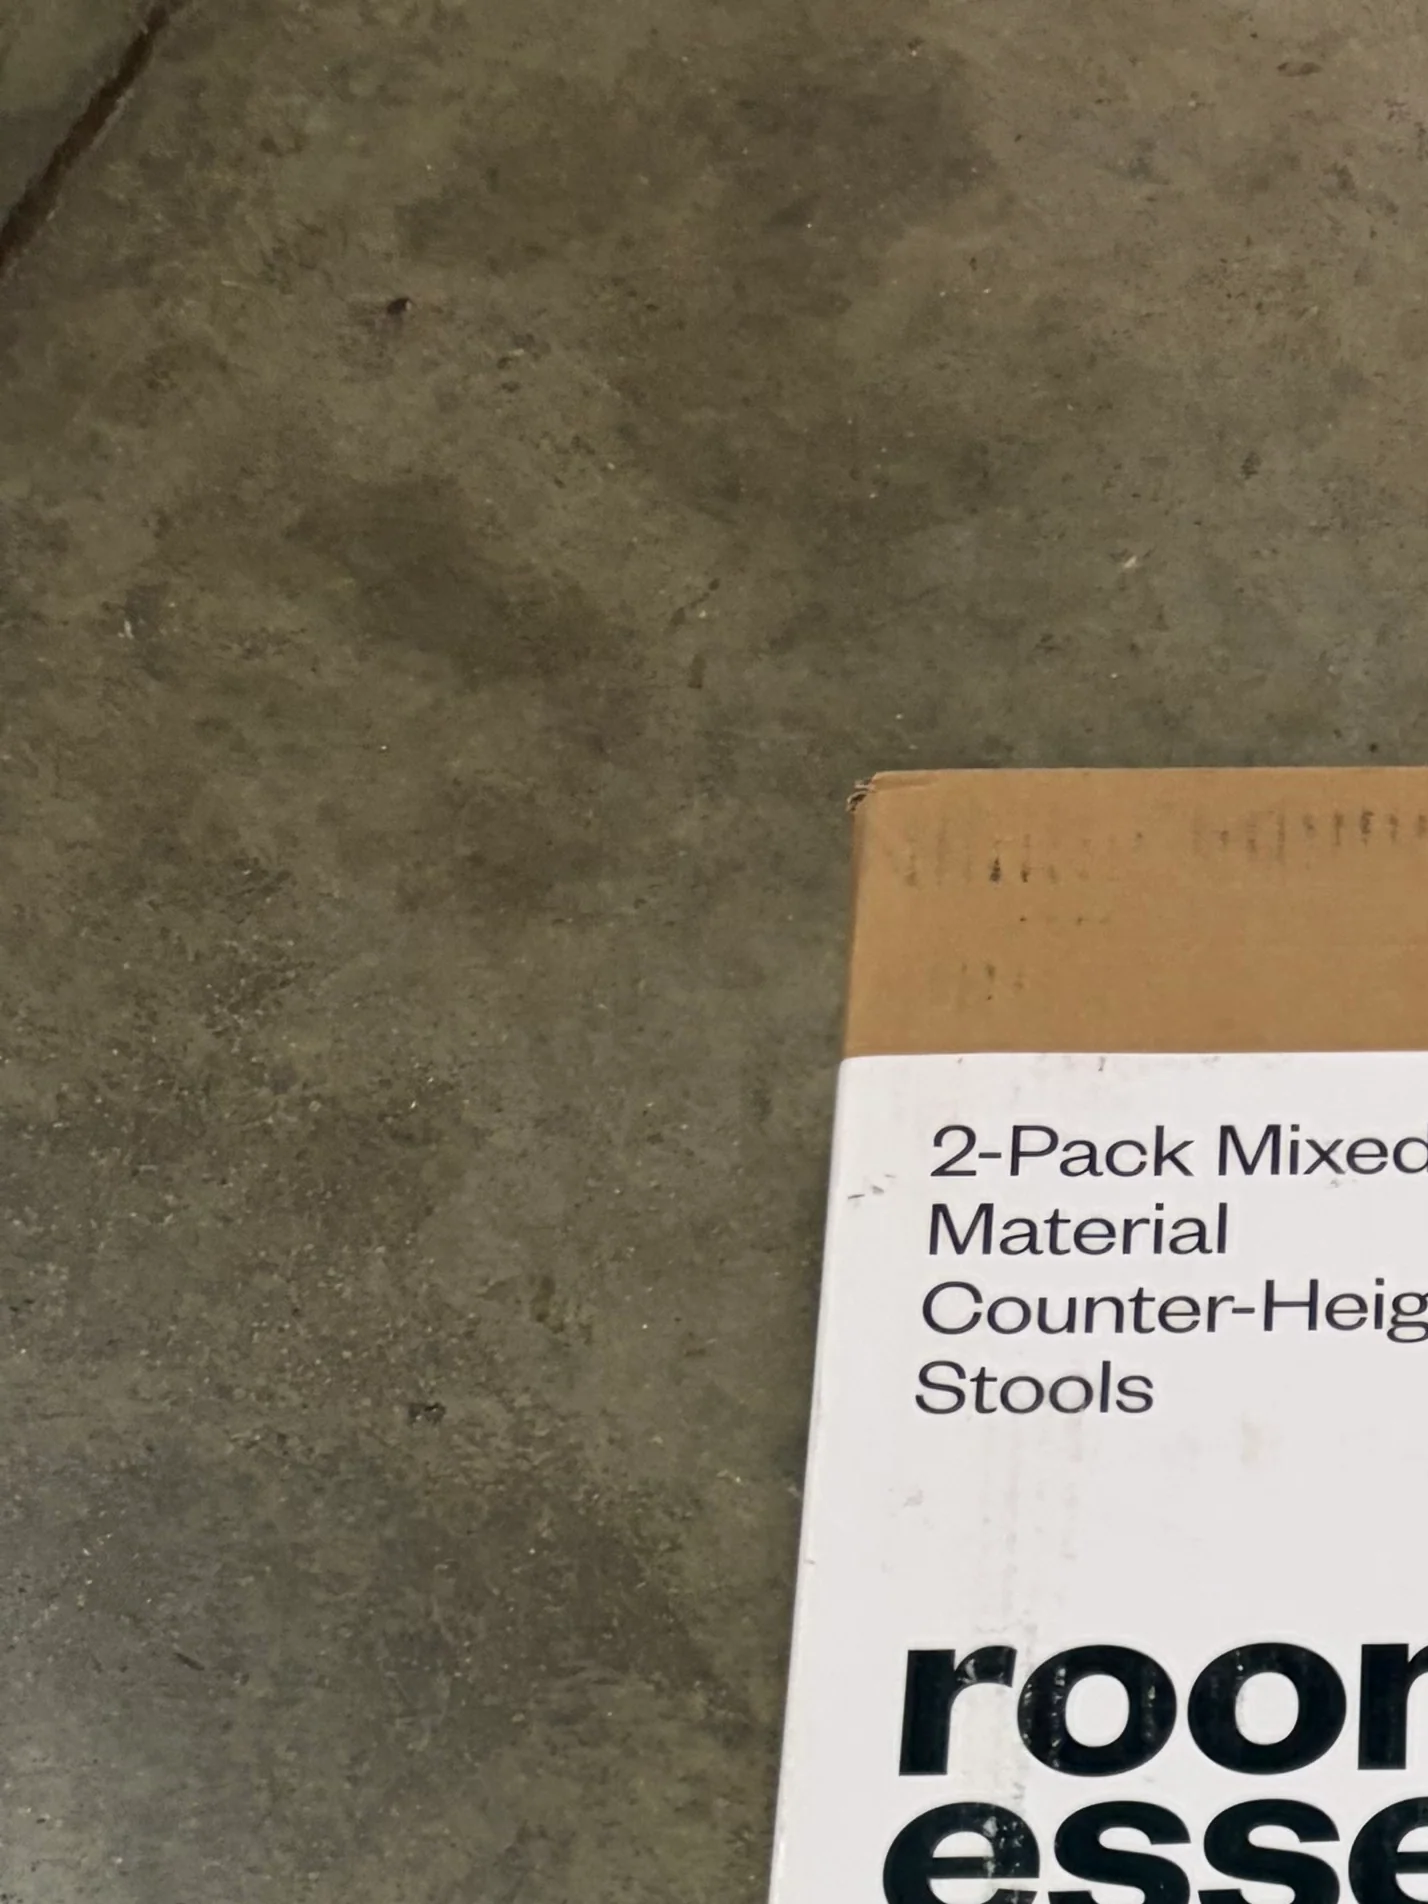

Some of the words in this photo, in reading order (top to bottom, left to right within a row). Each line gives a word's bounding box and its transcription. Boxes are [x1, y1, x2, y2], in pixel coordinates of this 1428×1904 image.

[931, 1125, 1193, 1177] 2-Pack
[929, 1203, 1227, 1255] Material
[916, 1361, 1153, 1414] Stools
